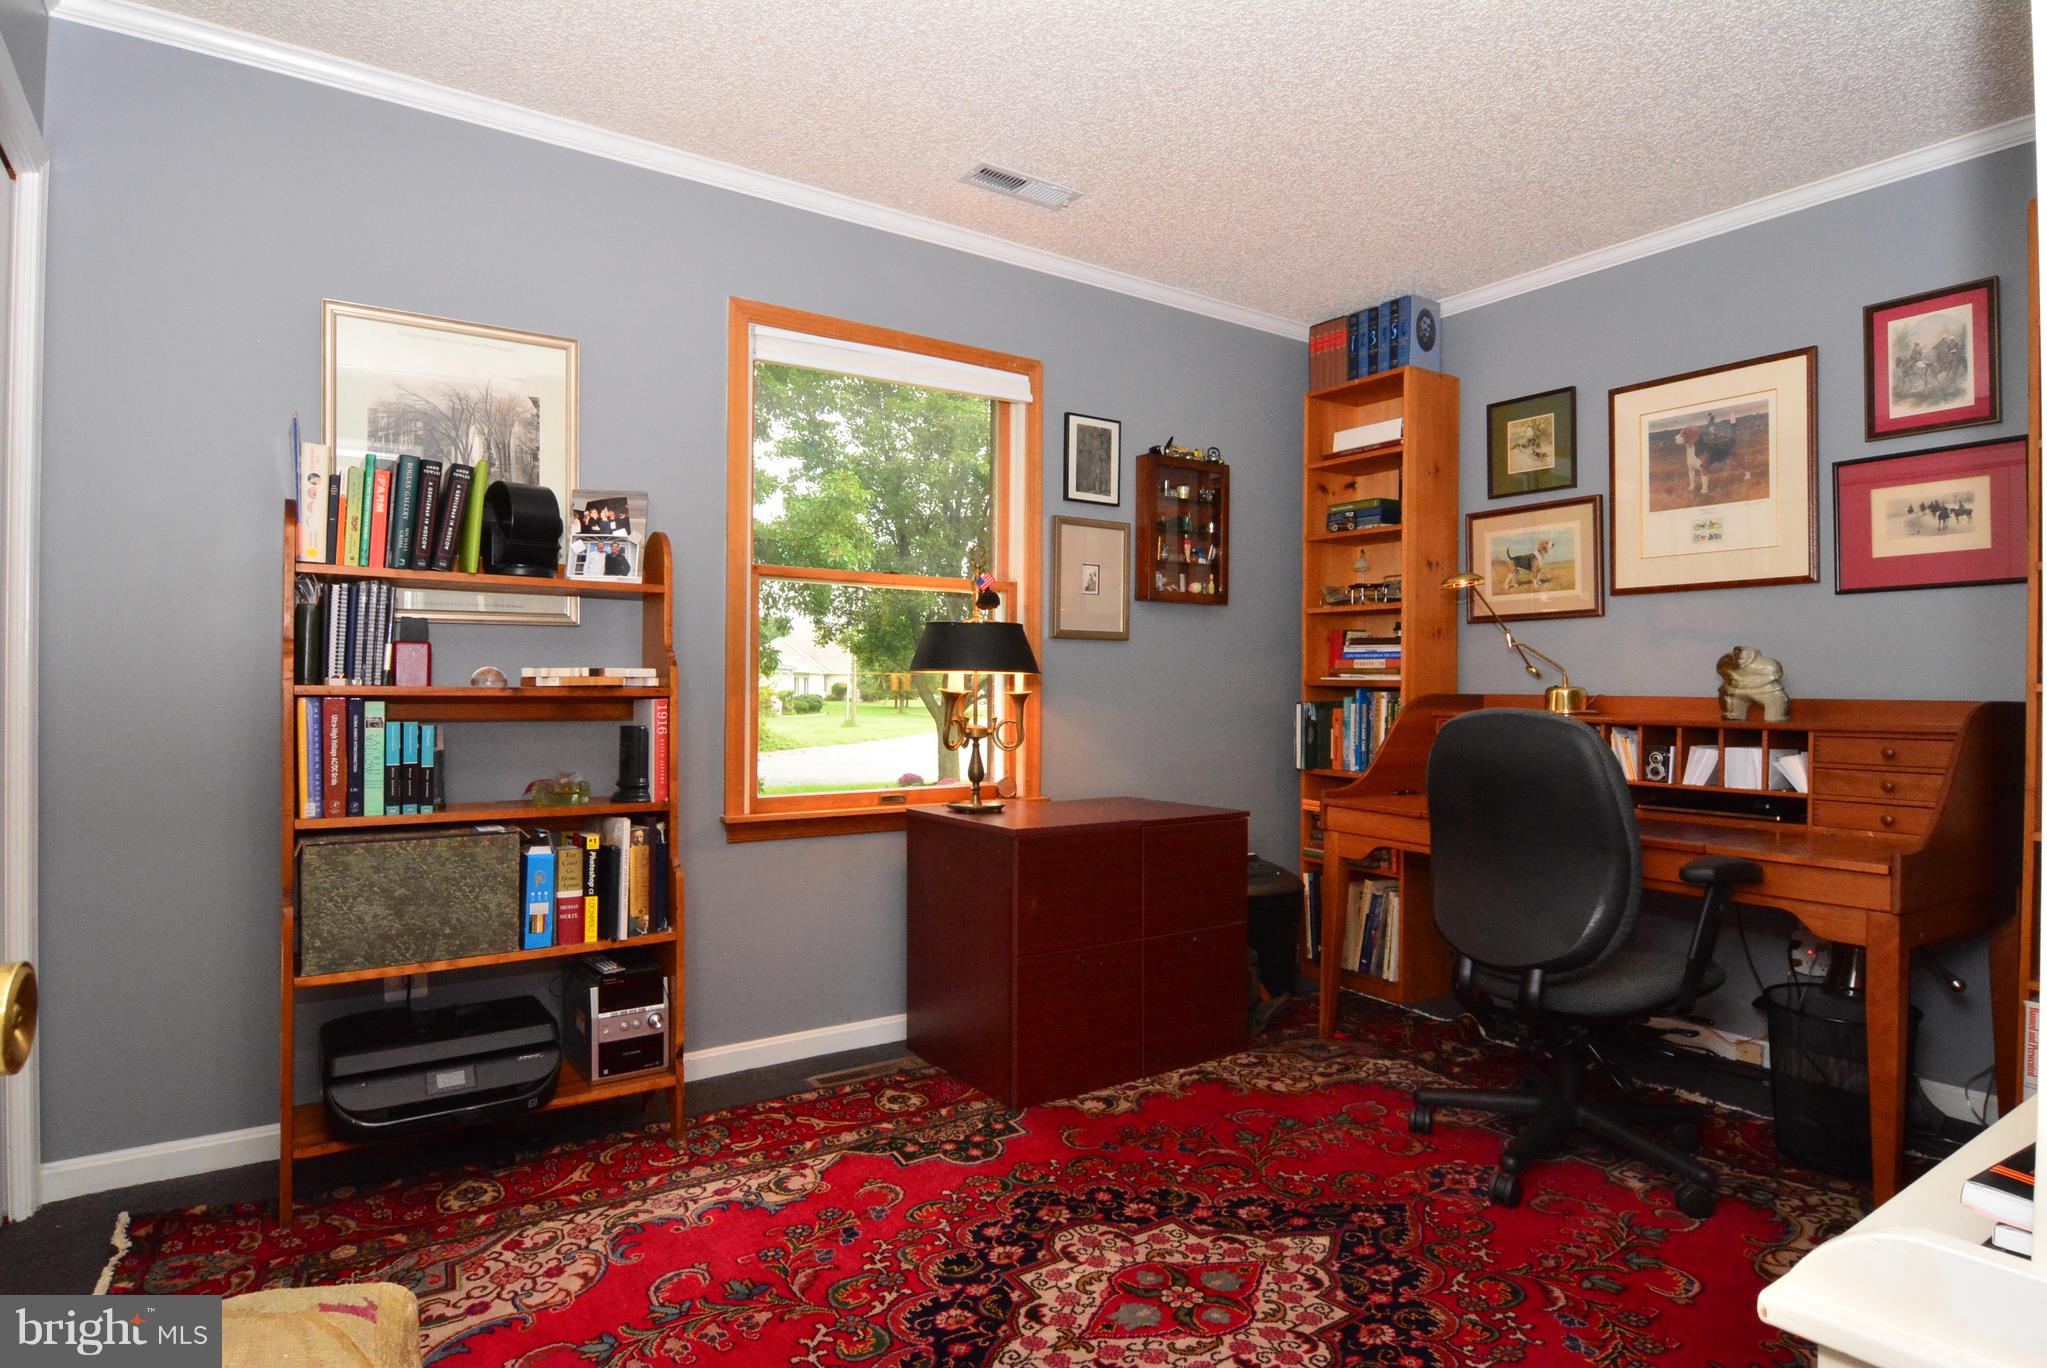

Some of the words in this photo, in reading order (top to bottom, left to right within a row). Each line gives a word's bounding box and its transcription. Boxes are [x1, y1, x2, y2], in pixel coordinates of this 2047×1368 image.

[1370, 330, 1376, 345] 3
[1392, 323, 1397, 339] 5
[1352, 336, 1355, 352] 1
[425, 486, 433, 516] GENTLEMAN
[452, 490, 461, 519] GENTLEMAN
[444, 527, 452, 550] MOSCOW
[657, 705, 667, 735] 1916
[2029, 1031, 2039, 1044] and
[2028, 1044, 2038, 1077] Persecuted
